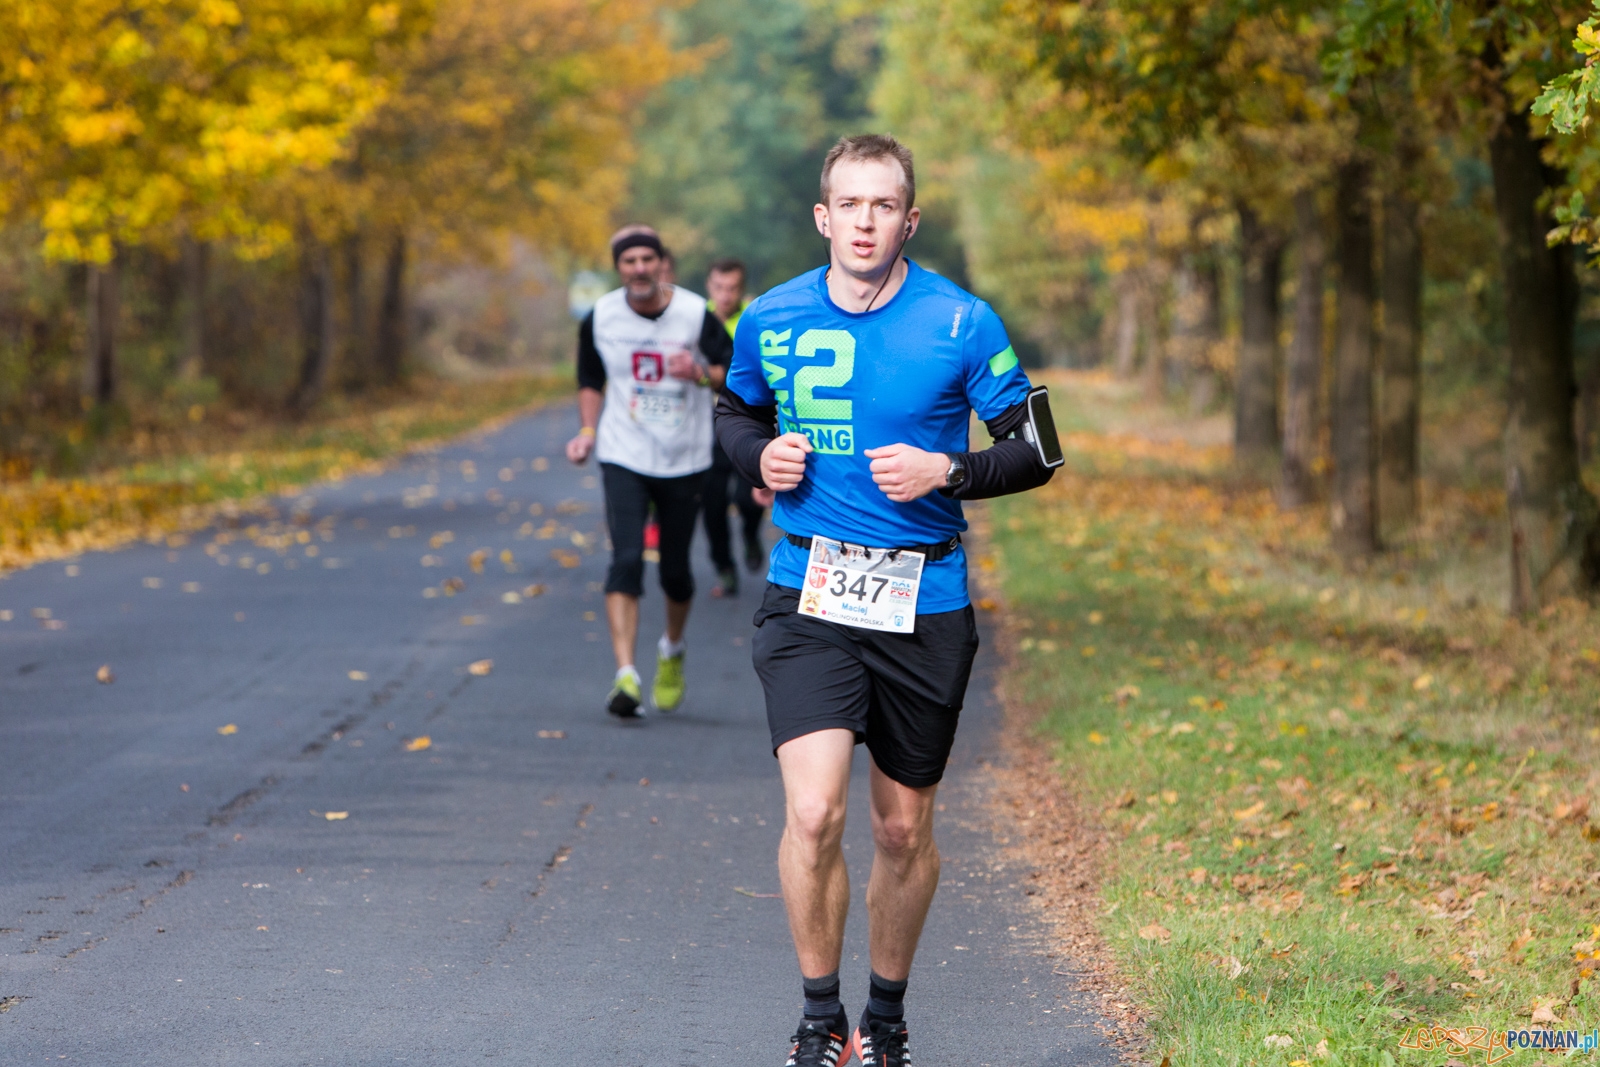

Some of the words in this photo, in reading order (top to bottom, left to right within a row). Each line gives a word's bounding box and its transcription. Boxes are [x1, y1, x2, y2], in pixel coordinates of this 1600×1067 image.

[790, 328, 856, 420] 2
[829, 569, 889, 604] 347
[827, 611, 859, 623] POLINOVA
[860, 617, 884, 626] POLSKA
[841, 602, 869, 616] Maciej
